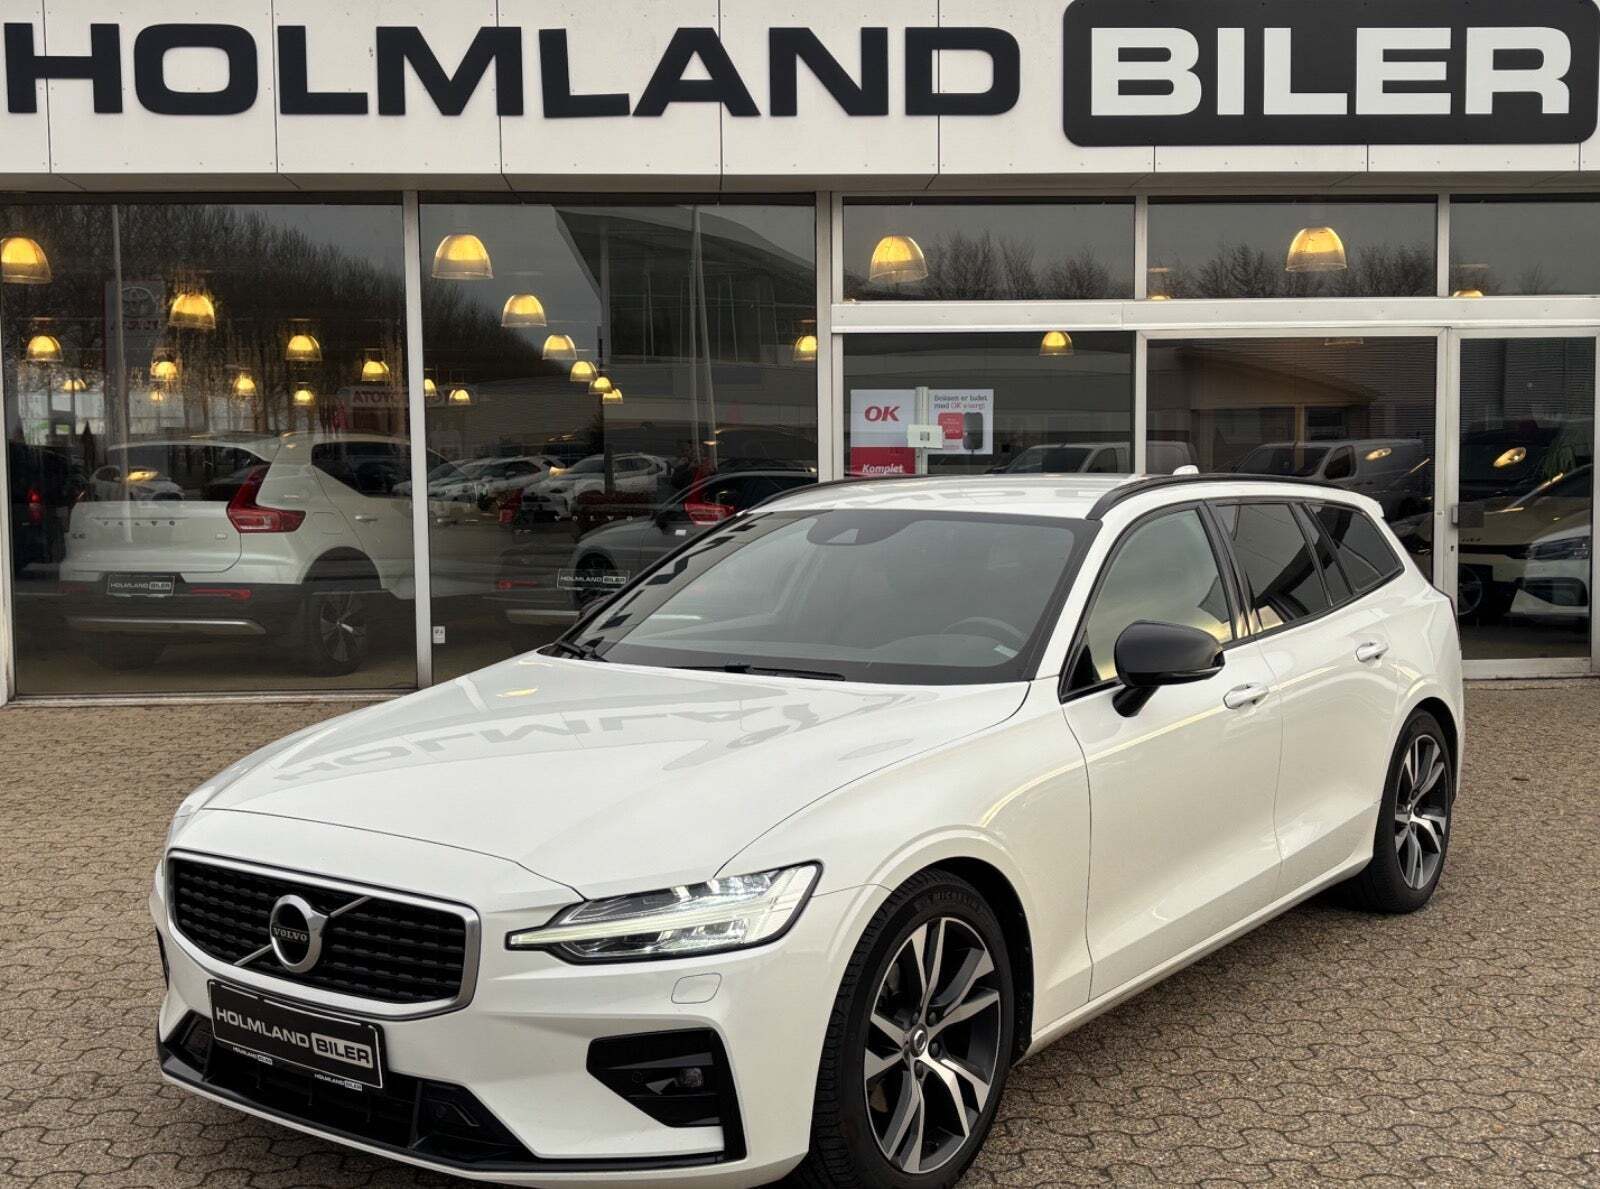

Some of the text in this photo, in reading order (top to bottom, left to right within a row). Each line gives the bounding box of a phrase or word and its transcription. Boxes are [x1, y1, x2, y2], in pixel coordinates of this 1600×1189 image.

[4, 23, 1572, 116] HOLMLAND BILER
[864, 406, 901, 422] OK
[862, 463, 904, 475] Komplet
[273, 927, 308, 942] VOLVO
[215, 1006, 370, 1065] HOLMLAND BILER
[314, 1073, 345, 1086] HOLMLAND
